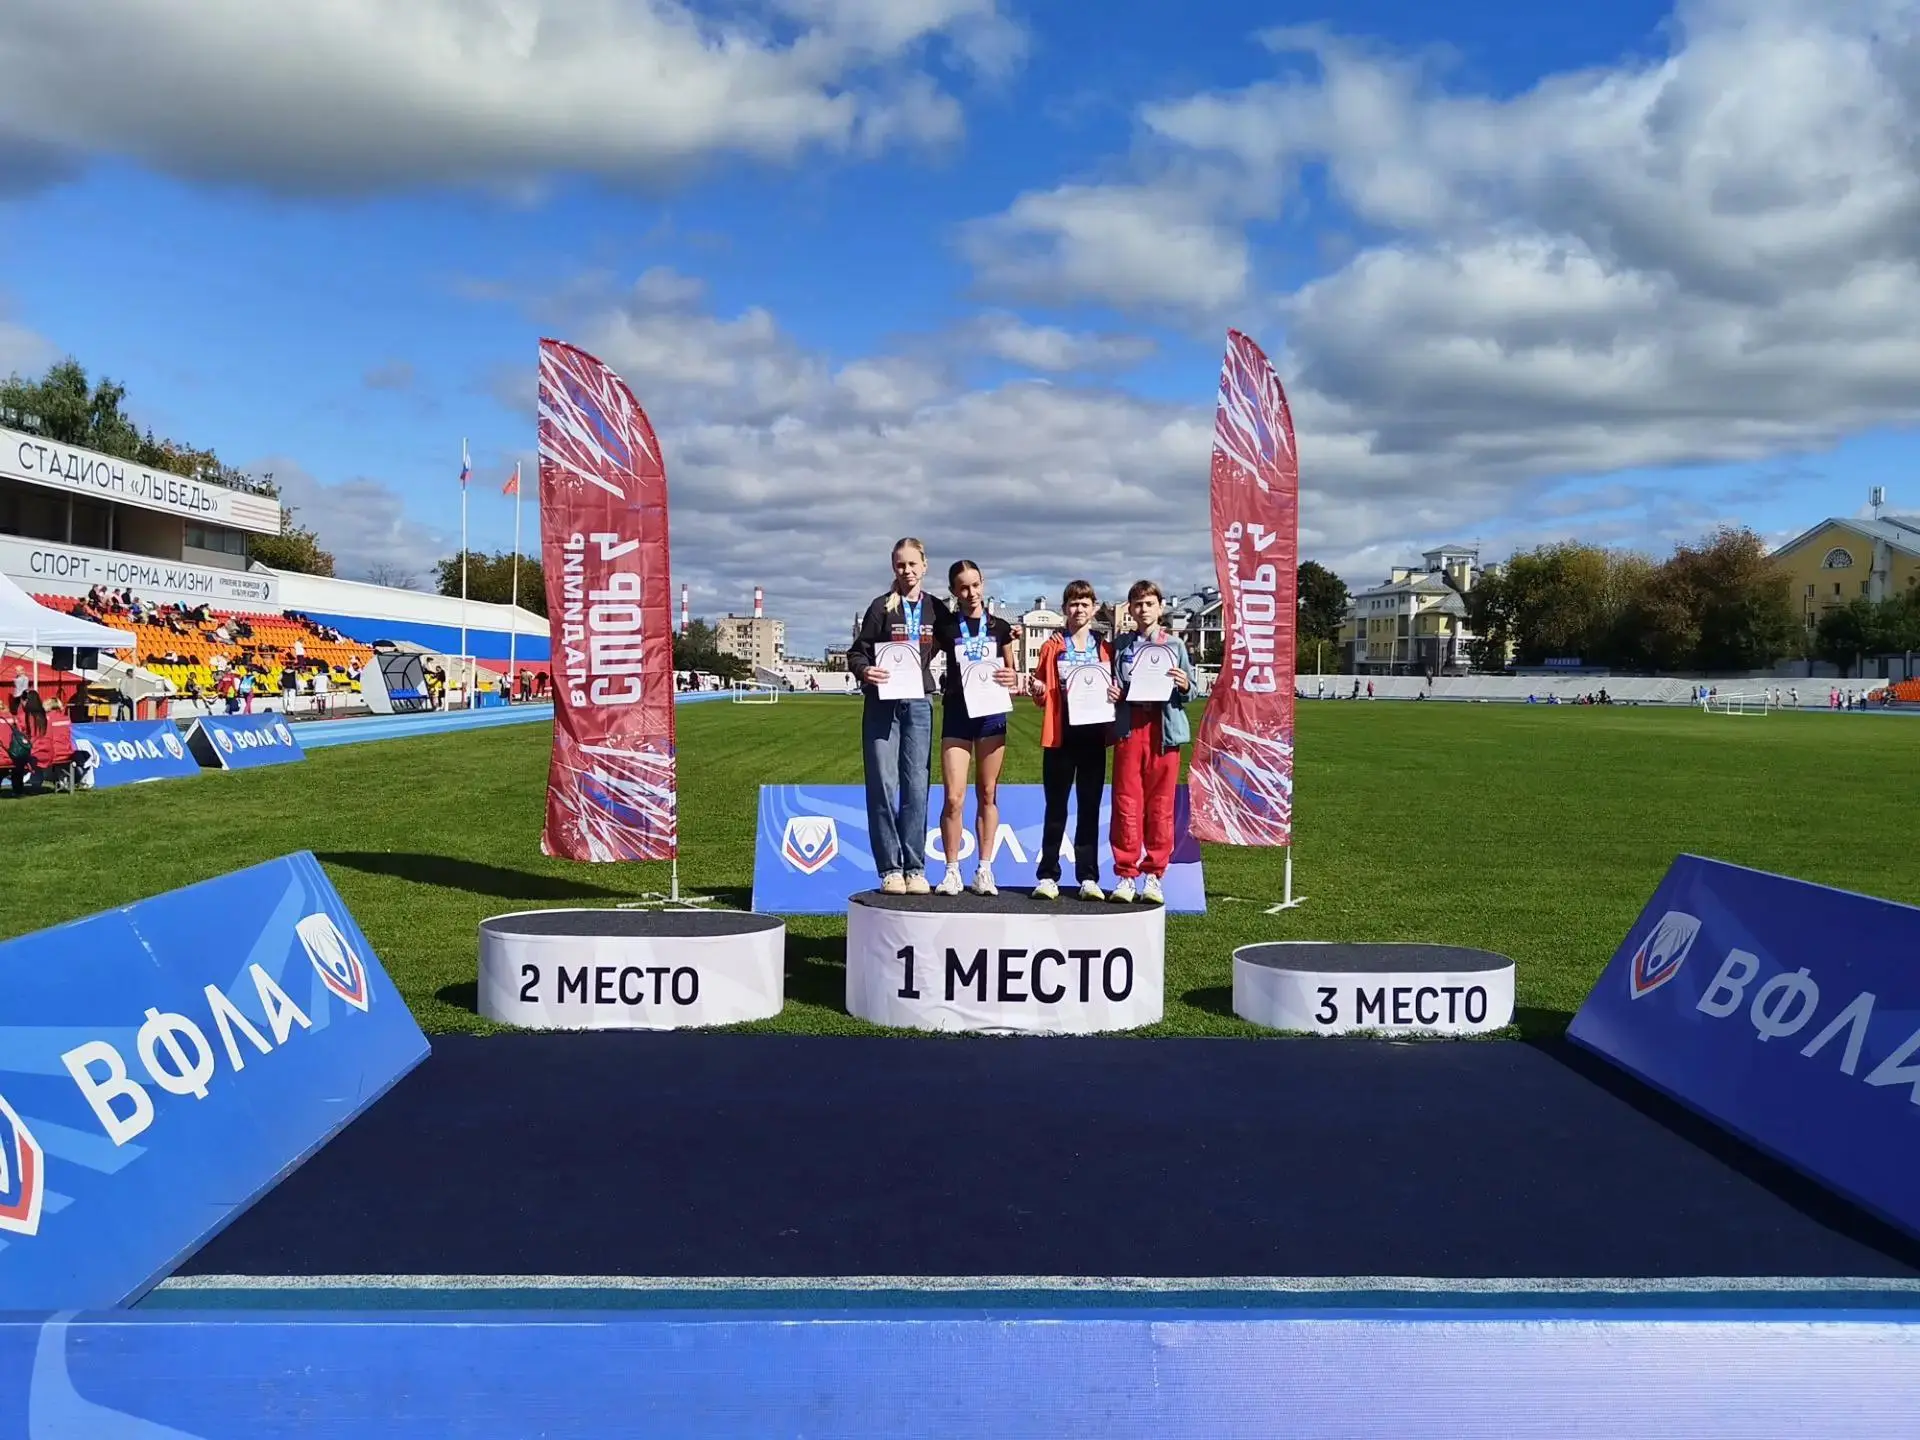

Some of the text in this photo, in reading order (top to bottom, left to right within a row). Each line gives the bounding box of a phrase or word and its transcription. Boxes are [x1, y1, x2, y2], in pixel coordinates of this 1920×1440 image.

[18, 442, 218, 513] СТАДИОН «ЛЫБЕДЬ»
[30, 551, 90, 579] СПОРТ
[106, 561, 160, 587] НОРМА
[164, 569, 213, 593] ЖИЗНИ
[102, 739, 163, 762] ВФЛА
[232, 728, 277, 750] ВФЛА
[519, 964, 700, 1005] 2 МЕСТО
[896, 945, 1134, 1004] 1 МЕСТО
[1314, 985, 1488, 1025] 3 МЕСТО
[60, 963, 313, 1147] ВФЛА
